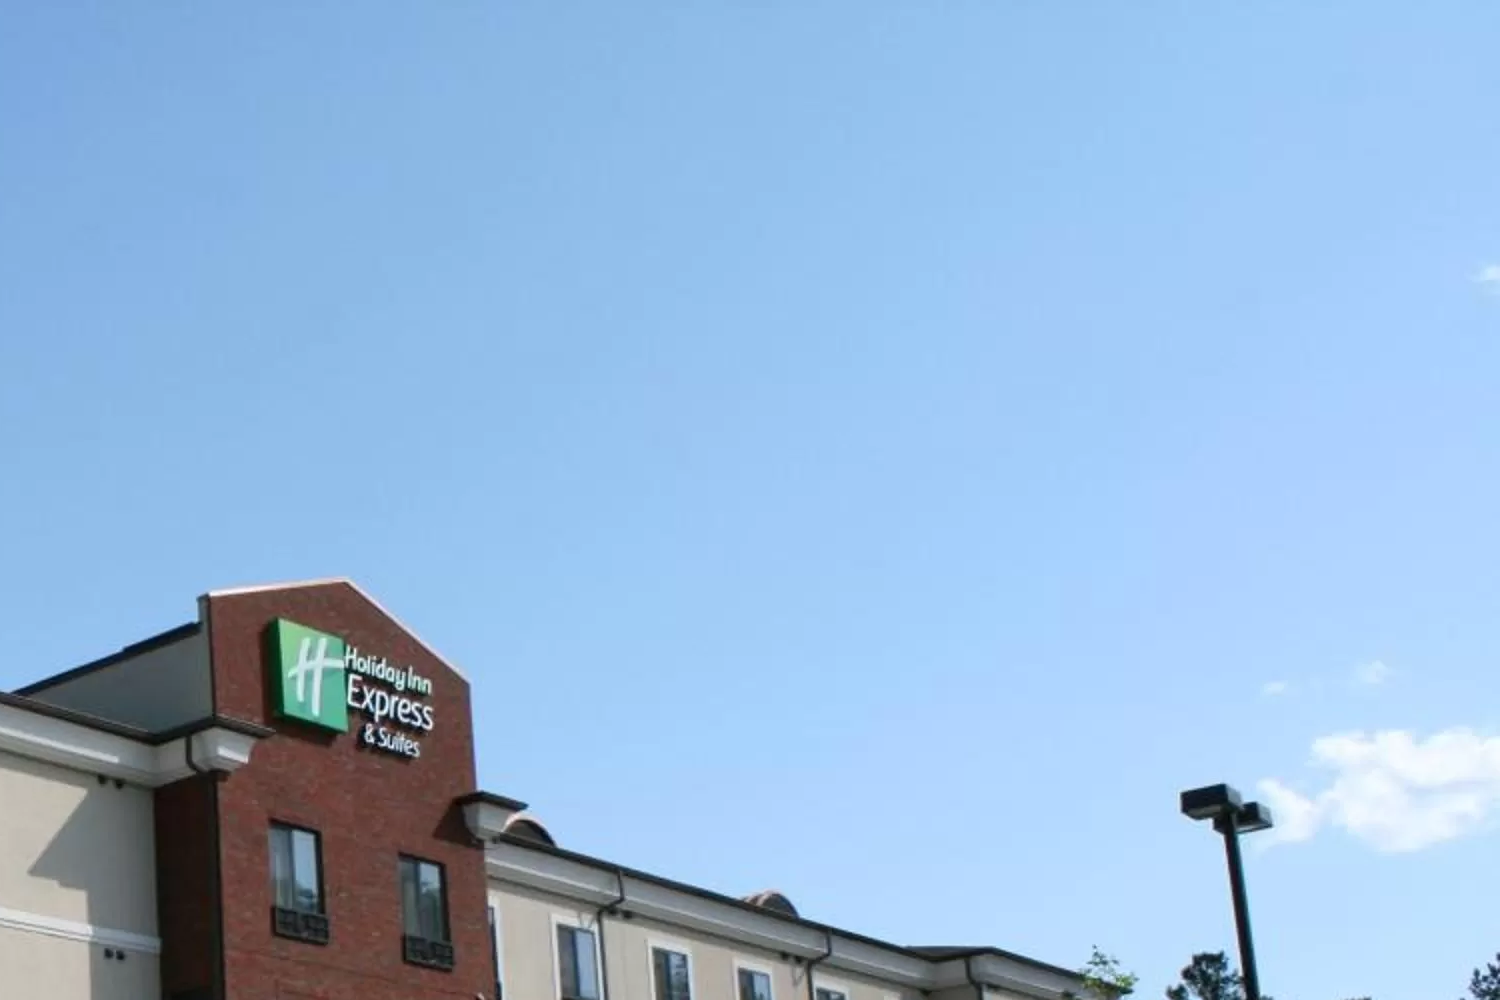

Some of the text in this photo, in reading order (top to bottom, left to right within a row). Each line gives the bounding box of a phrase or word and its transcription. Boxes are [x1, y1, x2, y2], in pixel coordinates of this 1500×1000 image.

[345, 644, 433, 695] Holiday Inn
[347, 674, 434, 731] Express
[364, 723, 420, 757] & Suites
